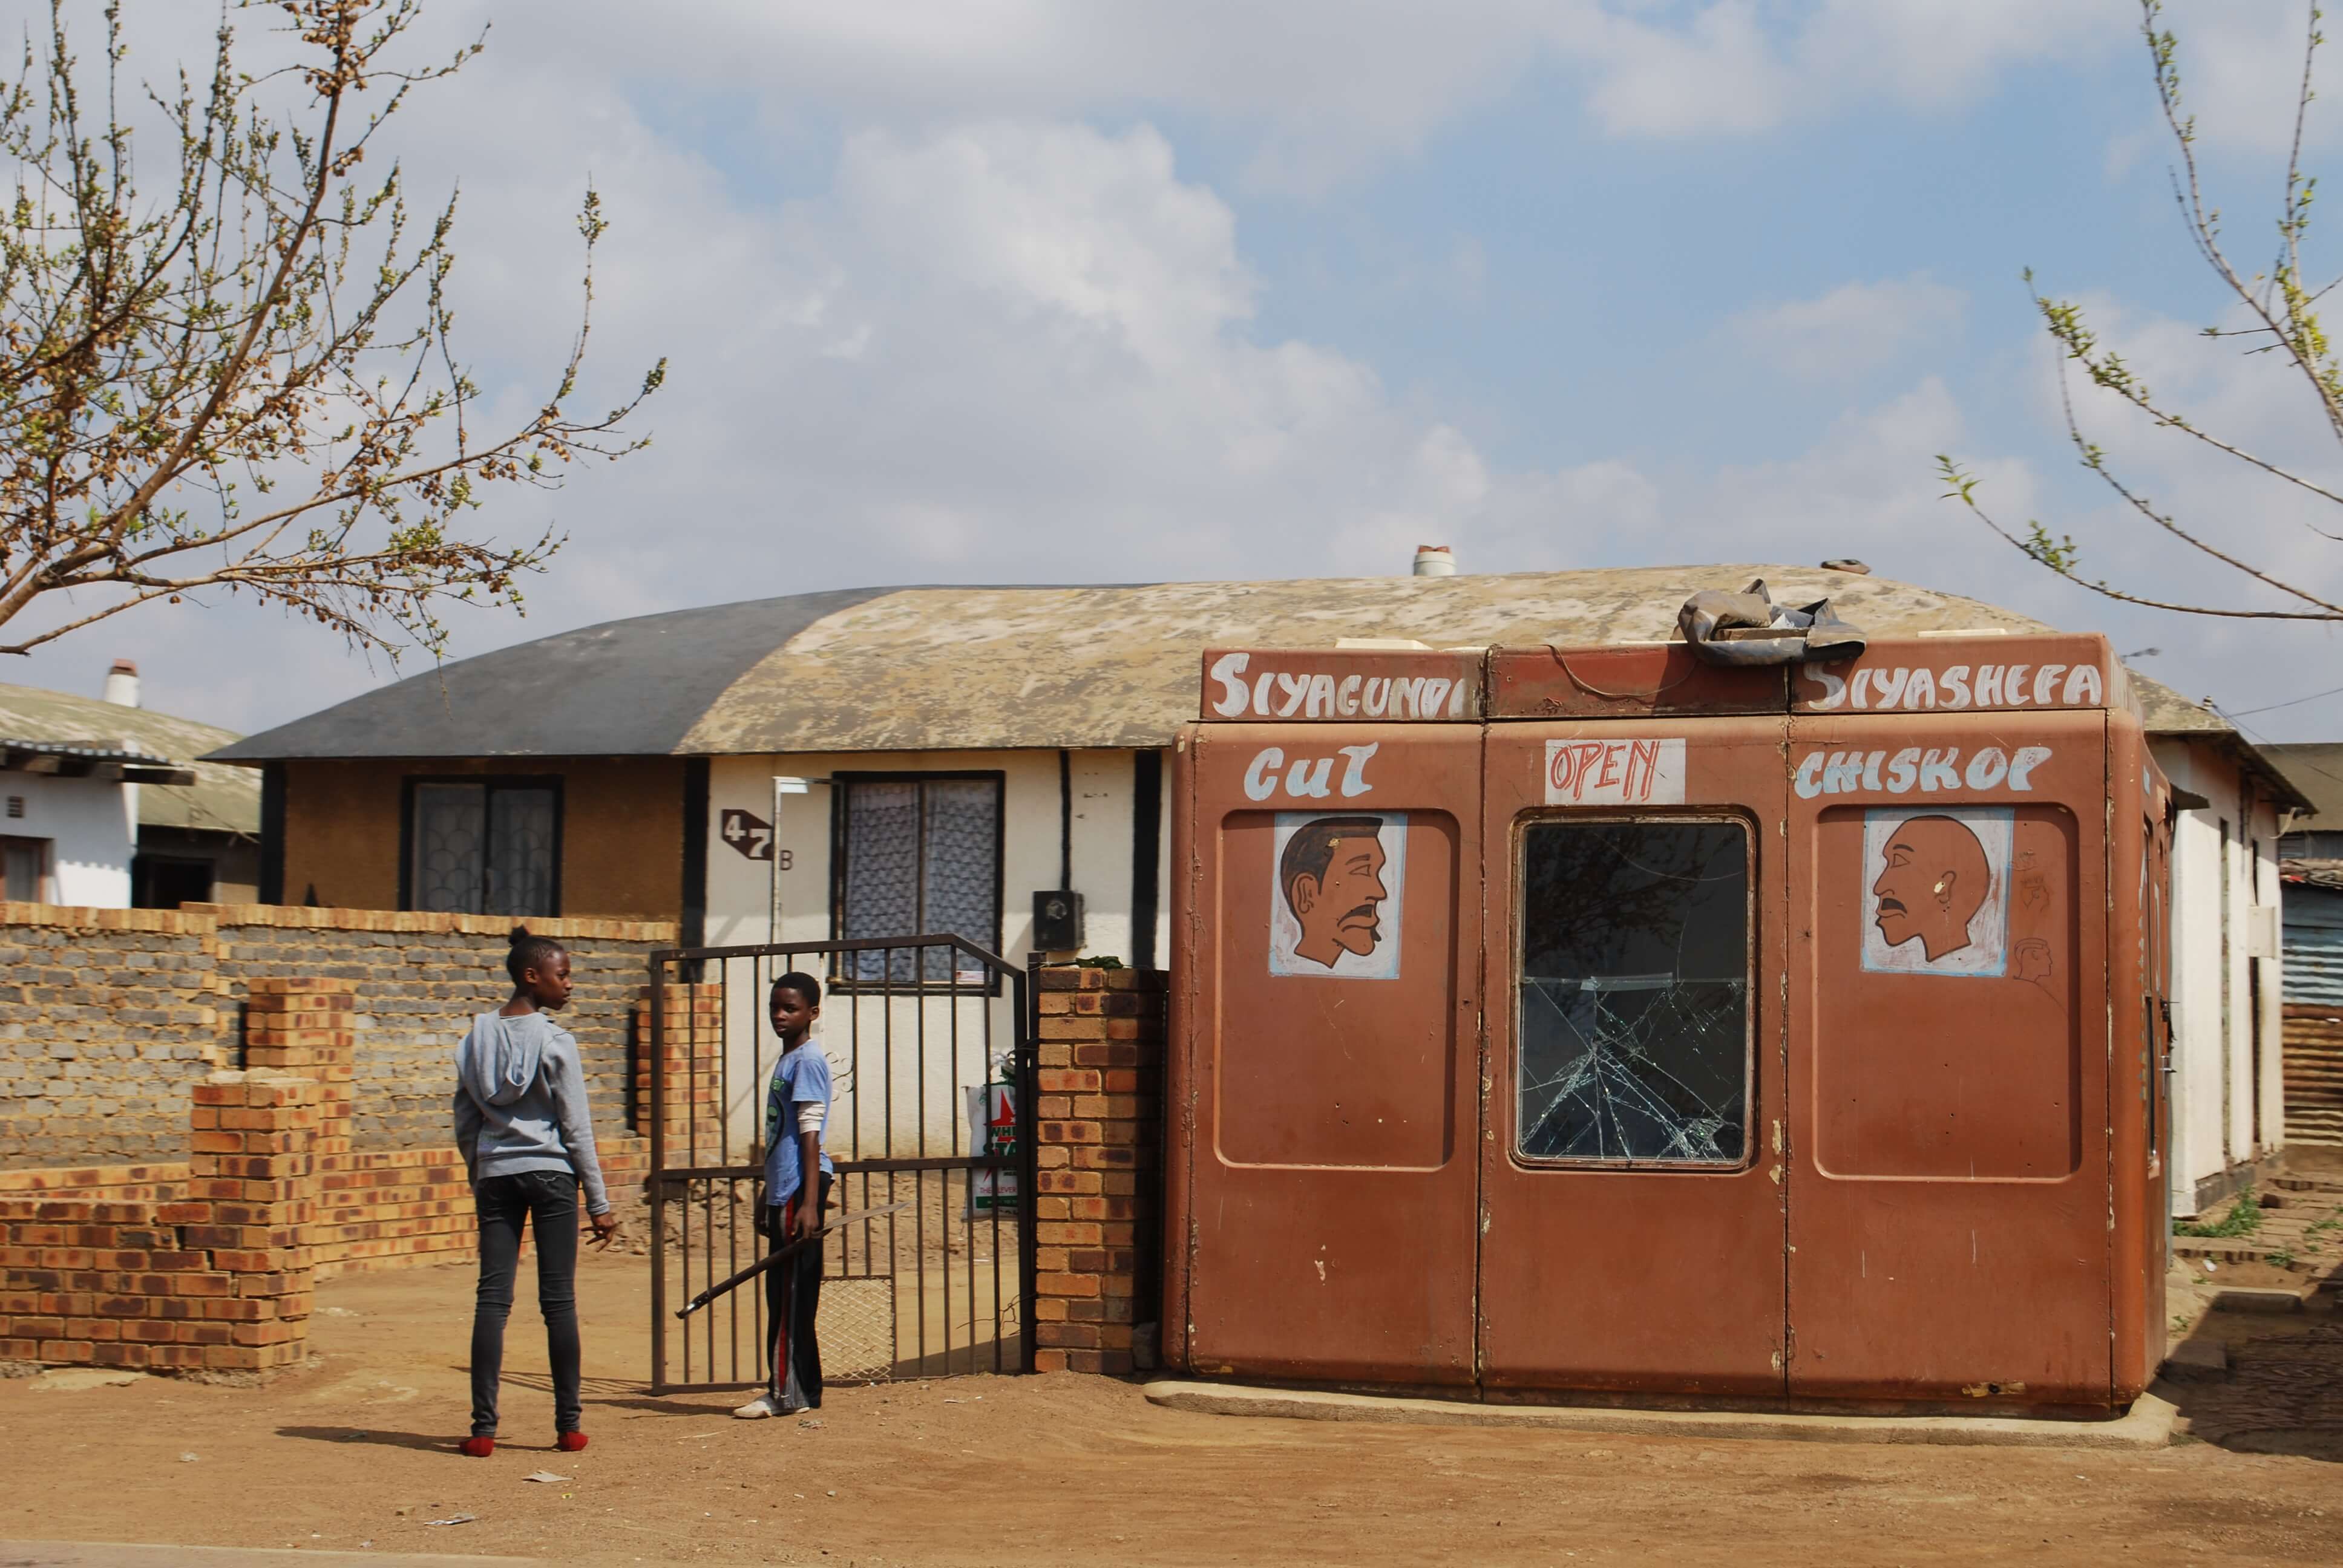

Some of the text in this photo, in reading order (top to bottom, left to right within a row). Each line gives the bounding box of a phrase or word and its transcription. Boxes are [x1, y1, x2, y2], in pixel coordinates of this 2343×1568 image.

[1803, 660, 2102, 710] SIYASHEFA
[1550, 739, 1660, 802] OPEN
[1794, 746, 2053, 799] CHISKOP
